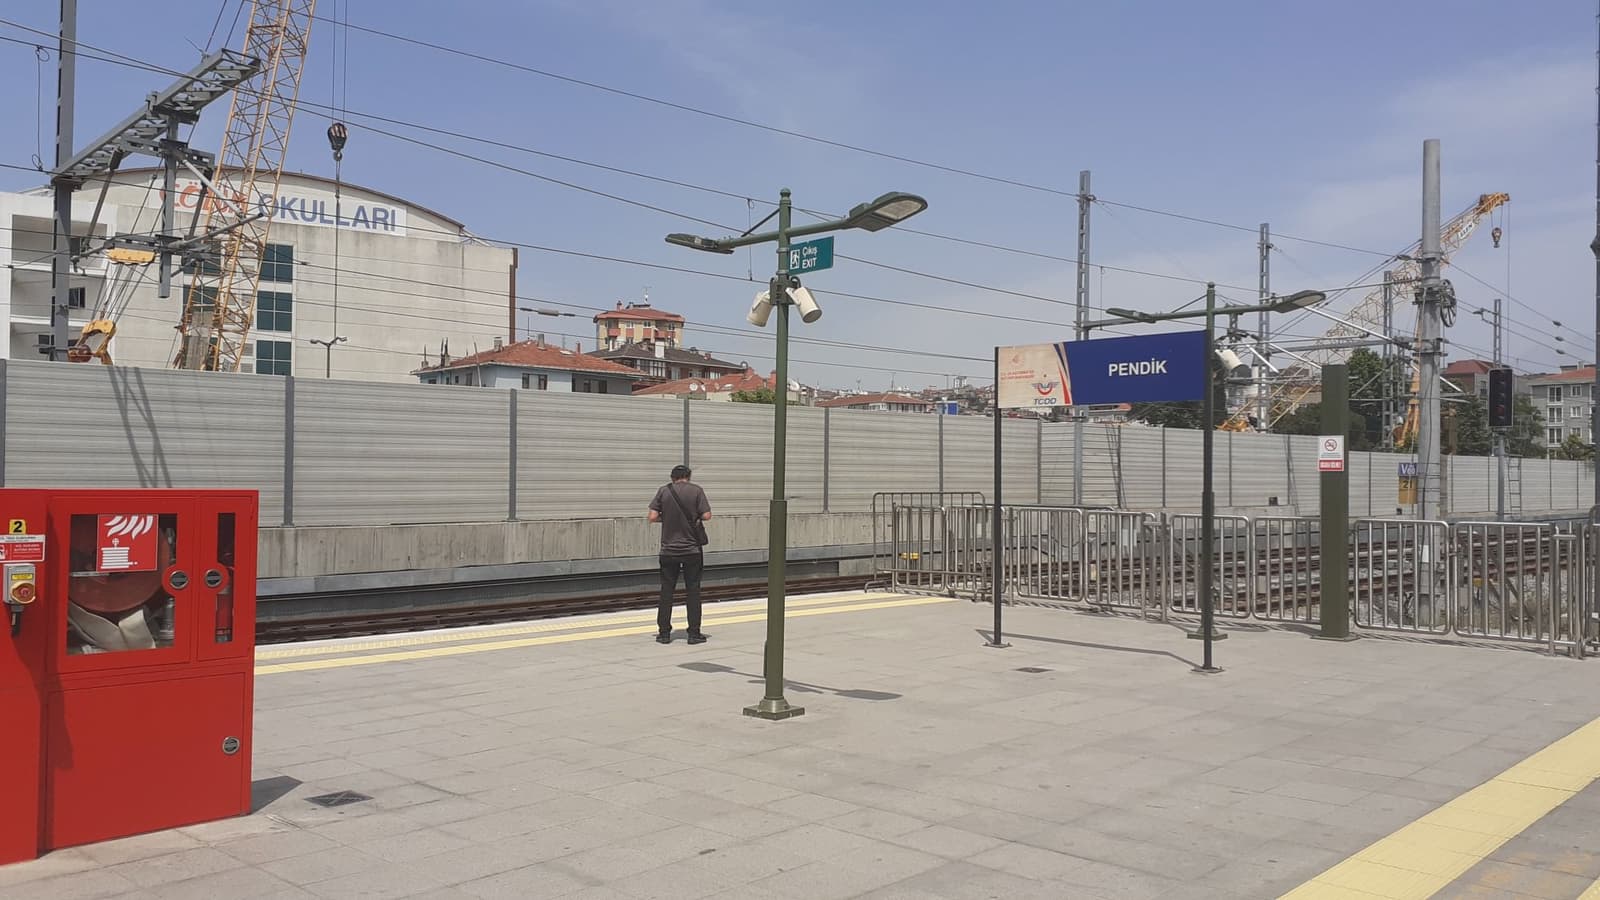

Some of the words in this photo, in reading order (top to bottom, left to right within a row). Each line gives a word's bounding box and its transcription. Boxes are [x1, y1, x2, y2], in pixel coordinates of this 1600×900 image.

[258, 193, 396, 232] OKULLARI
[802, 258, 817, 269] EXIT
[1108, 357, 1168, 377] PENDİK
[14, 521, 22, 532] 2
